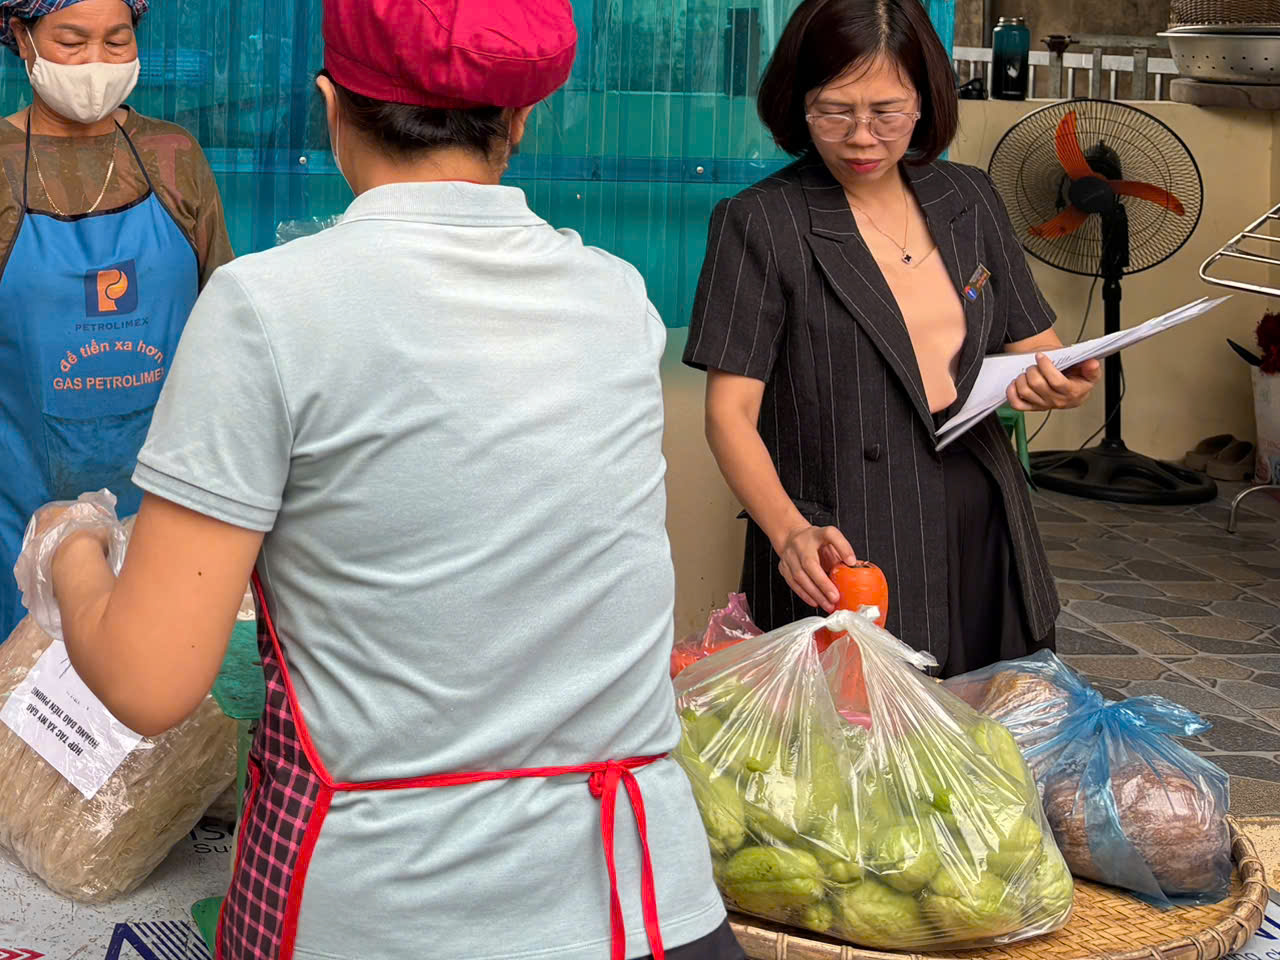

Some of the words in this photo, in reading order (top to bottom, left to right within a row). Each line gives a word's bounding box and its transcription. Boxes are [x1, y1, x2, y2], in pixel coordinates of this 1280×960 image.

[75, 318, 149, 331] PETROLIMEX
[114, 341, 133, 351] xa
[137, 340, 164, 364] hơn
[53, 376, 83, 390] GAS
[193, 843, 232, 854] Su
